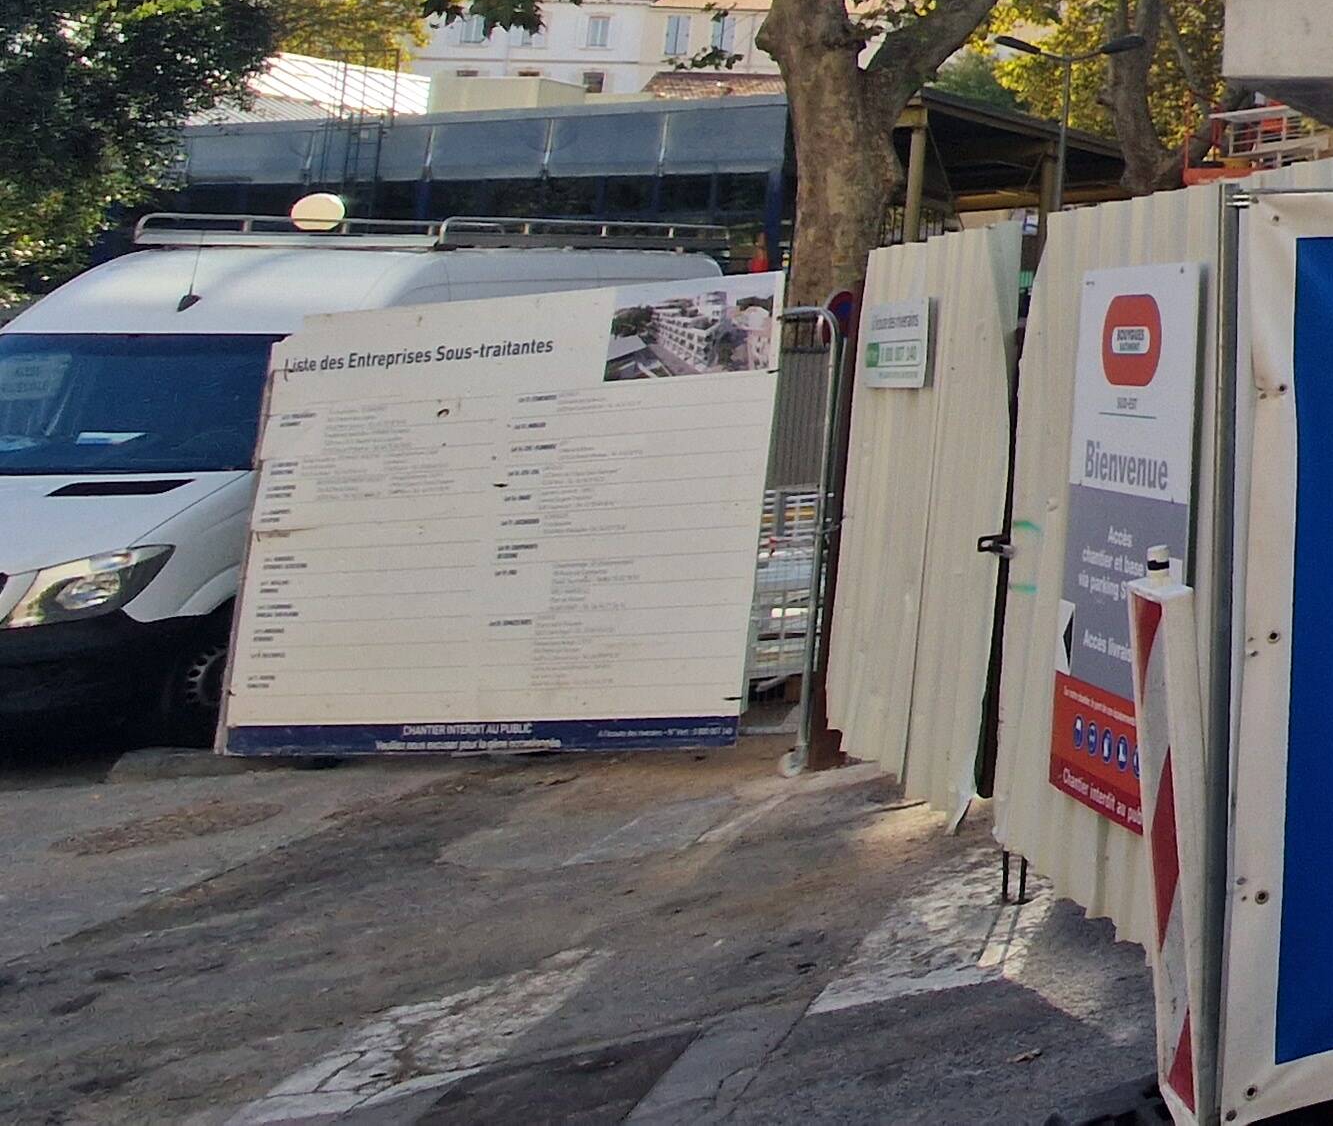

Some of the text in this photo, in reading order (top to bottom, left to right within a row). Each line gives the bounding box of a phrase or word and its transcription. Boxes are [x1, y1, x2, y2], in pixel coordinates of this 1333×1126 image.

[320, 354, 344, 370] des
[348, 348, 432, 369] Entreprises
[435, 338, 554, 362] Sous-traitantes
[1085, 439, 1168, 490] Bienvenue
[1108, 525, 1133, 548] Accès
[1082, 545, 1144, 577] chantier et base
[1079, 570, 1089, 588] via
[1090, 575, 1119, 601] parking
[1083, 629, 1107, 653] Accès
[403, 722, 533, 736] CHANTIER INTERDIT AU PUBLIC
[1063, 768, 1089, 796] Chantier
[1090, 782, 1115, 814] interdit
[1116, 800, 1127, 817] au
